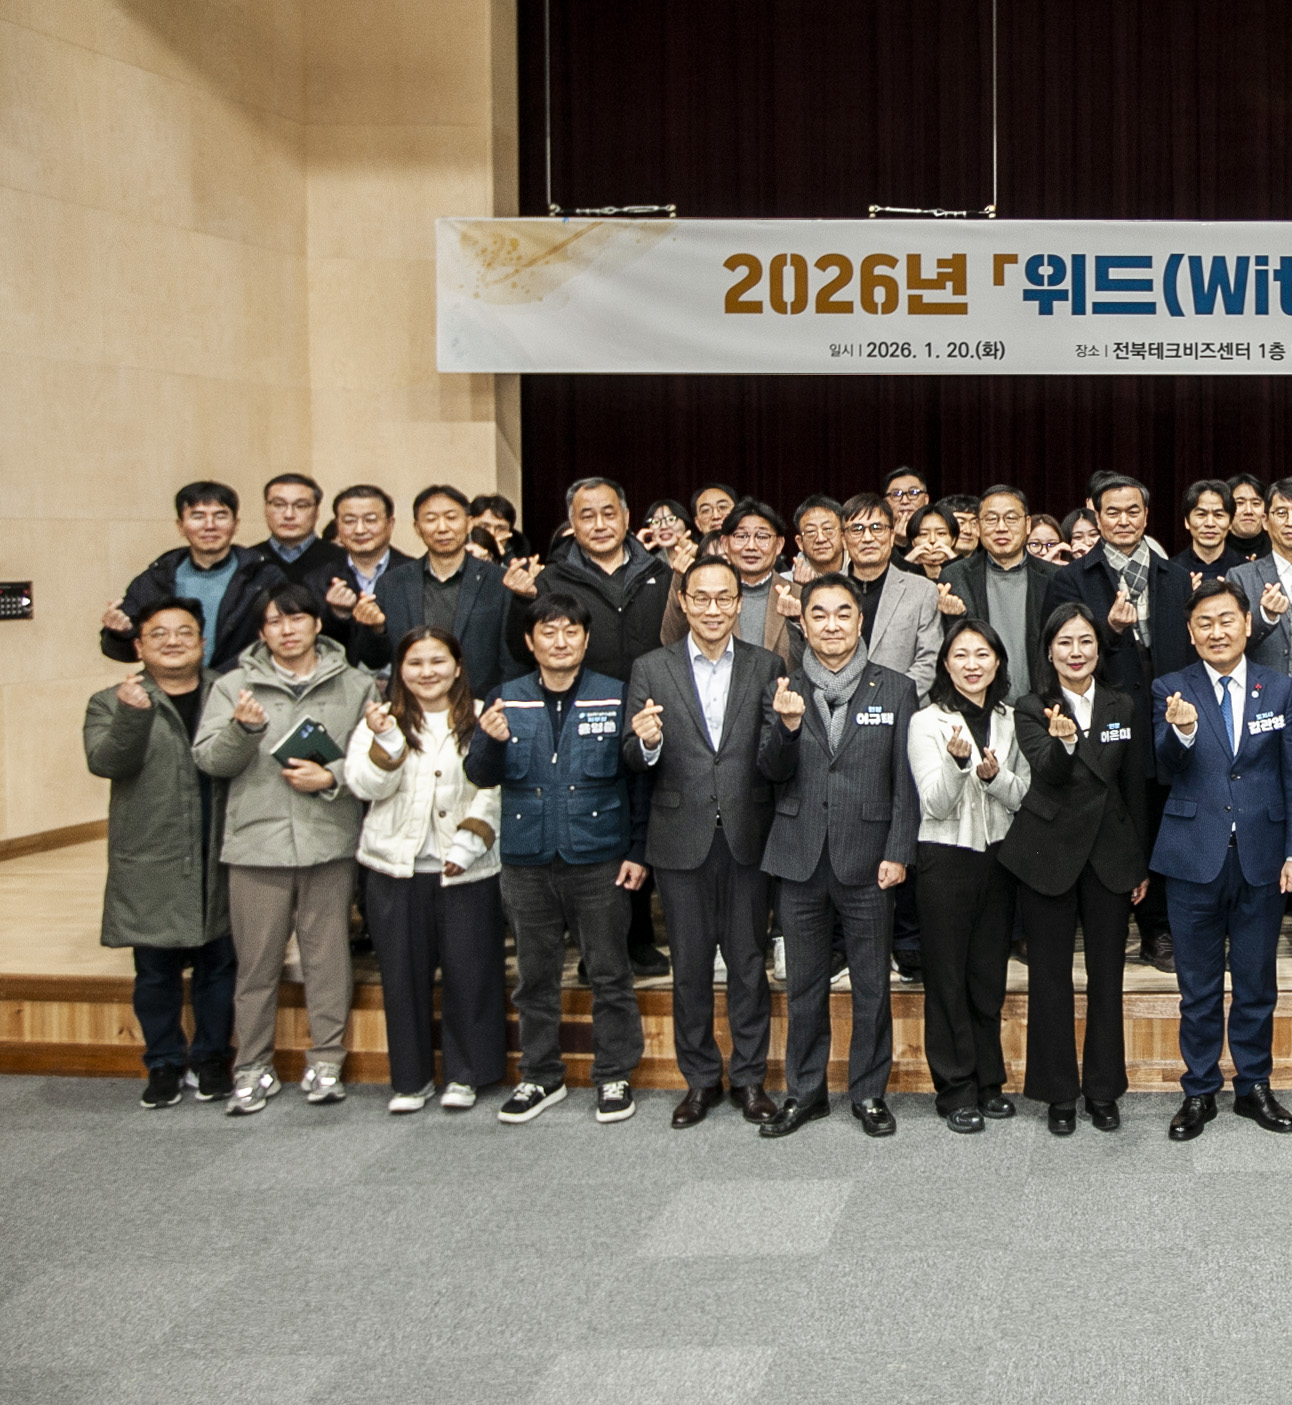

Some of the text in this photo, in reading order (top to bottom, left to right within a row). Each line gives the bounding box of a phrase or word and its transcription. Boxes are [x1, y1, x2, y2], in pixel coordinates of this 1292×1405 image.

[723, 253, 968, 314] 2026년
[829, 341, 1006, 360] 일시 2026. 1. 20.(화)
[1075, 344, 1101, 358] 장소
[1113, 342, 1251, 360] 전북테크비즈센터
[1258, 342, 1286, 361] 1층
[855, 712, 895, 725] 이규택
[1100, 728, 1131, 743] 이은미
